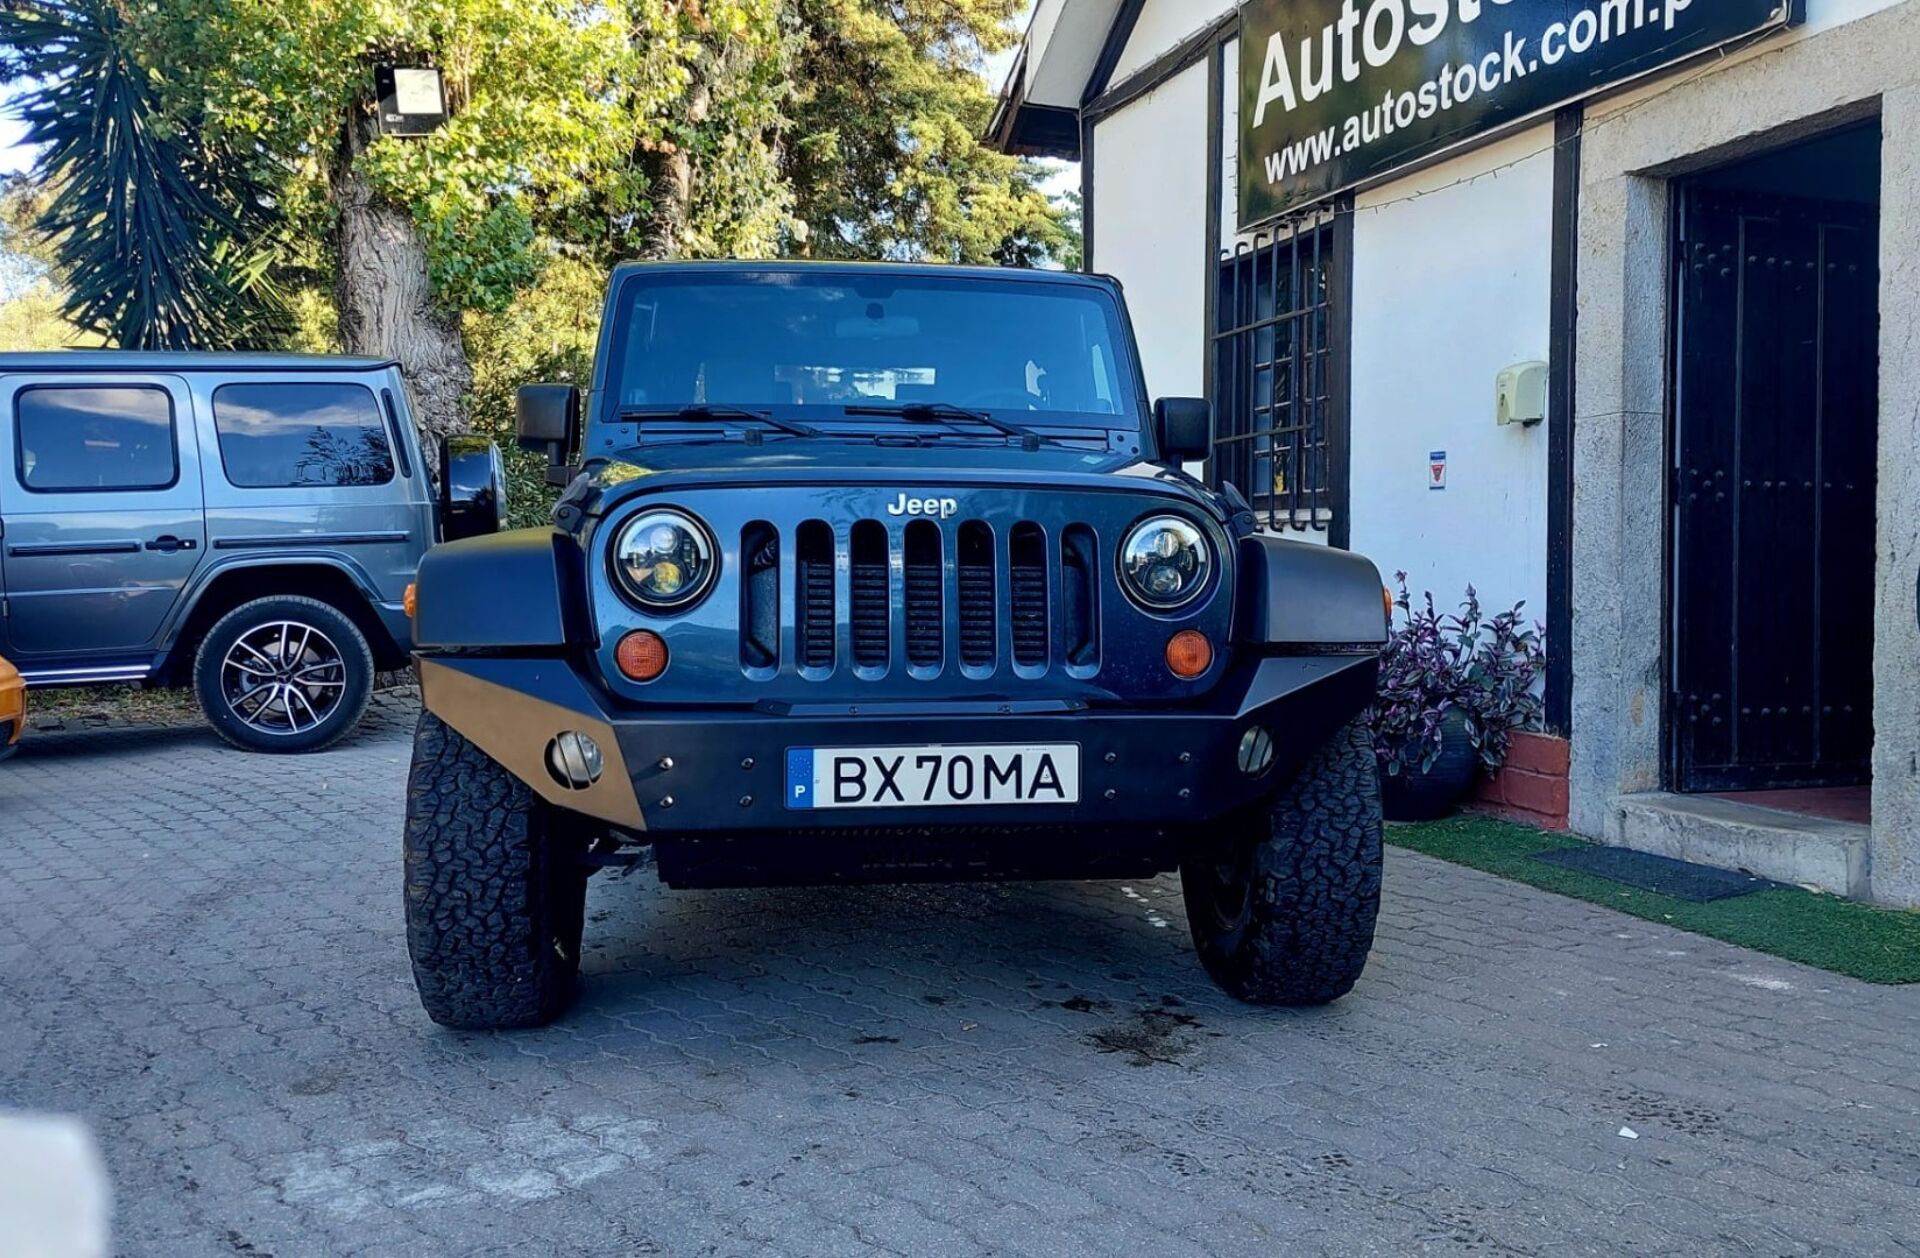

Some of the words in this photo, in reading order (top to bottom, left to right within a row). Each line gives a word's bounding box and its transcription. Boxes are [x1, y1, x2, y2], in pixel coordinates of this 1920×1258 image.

[1253, 0, 1513, 129] Autos
[888, 493, 958, 519] Jeep
[794, 784, 806, 799] P
[833, 753, 1066, 803] BX70MA
